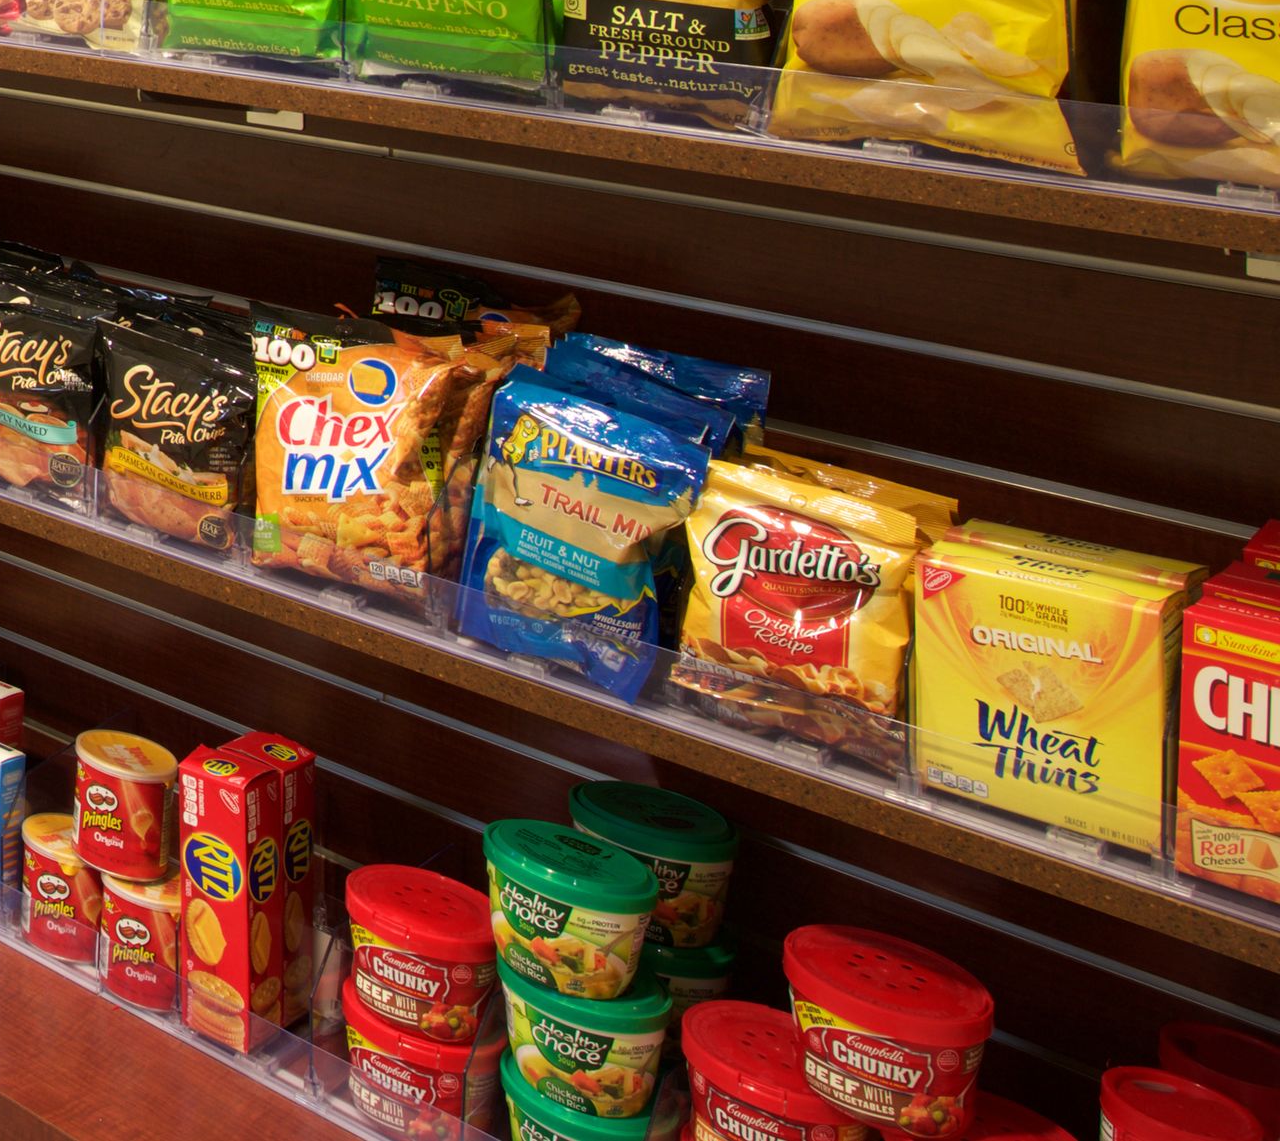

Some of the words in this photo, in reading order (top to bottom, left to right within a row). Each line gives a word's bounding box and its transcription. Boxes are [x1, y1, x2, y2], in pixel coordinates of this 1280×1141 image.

[611, 6, 684, 33] SALT
[688, 19, 706, 36] &
[590, 24, 643, 42] FRESH
[649, 32, 731, 53] GROUND
[599, 39, 719, 75] PEPPER
[11, 374, 37, 392] Pita
[305, 371, 344, 383] CHEDDAR
[111, 365, 228, 443] Stacy's
[161, 428, 186, 445] Pita
[193, 425, 226, 443] Chips
[278, 397, 401, 448] Chex
[702, 516, 882, 598] Gardetto's
[999, 594, 1035, 615] 100%
[1035, 602, 1069, 617] WHOLE
[1035, 610, 1069, 626] GRAIN
[753, 624, 815, 656] Recipe
[970, 625, 1104, 664] ORIGINAL
[1218, 633, 1277, 660] Sunshine
[974, 698, 1105, 769] Wheat
[971, 742, 1100, 795] Thins
[83, 811, 123, 832] Pringles
[1200, 839, 1245, 856] Real
[1201, 855, 1245, 866] Cheese
[34, 900, 75, 918] Pringles
[499, 893, 560, 934] Choice
[505, 881, 565, 921] Healthy
[112, 945, 155, 965] Pringles
[372, 959, 441, 998] CHUNKY
[532, 1027, 601, 1065] Choice
[538, 1018, 607, 1054] Healthy
[831, 1040, 922, 1089] CHUNKY
